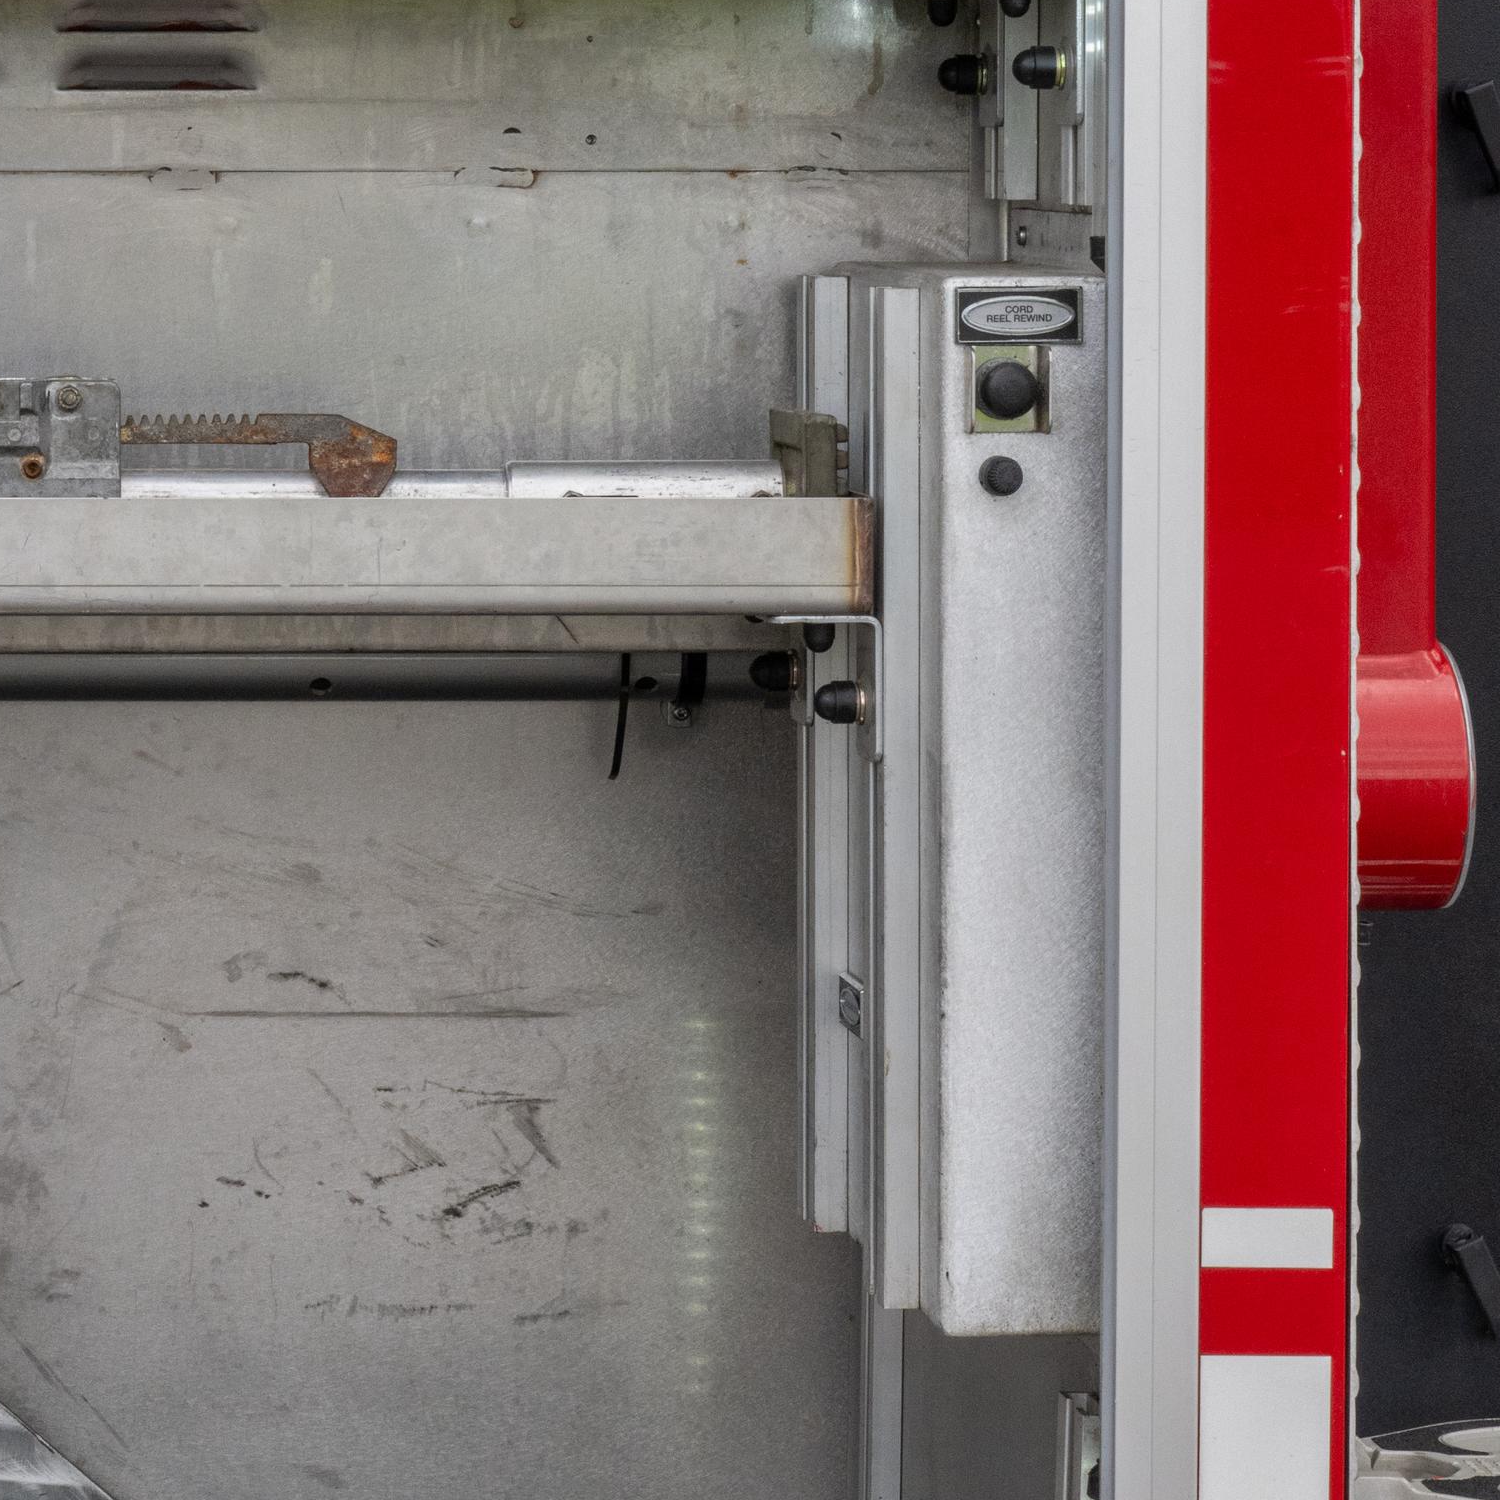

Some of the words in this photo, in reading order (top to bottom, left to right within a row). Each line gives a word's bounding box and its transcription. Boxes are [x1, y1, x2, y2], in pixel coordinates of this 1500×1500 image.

[1005, 305, 1033, 314] CORD
[986, 314, 1012, 323] REEL
[1013, 313, 1053, 323] REWIND
